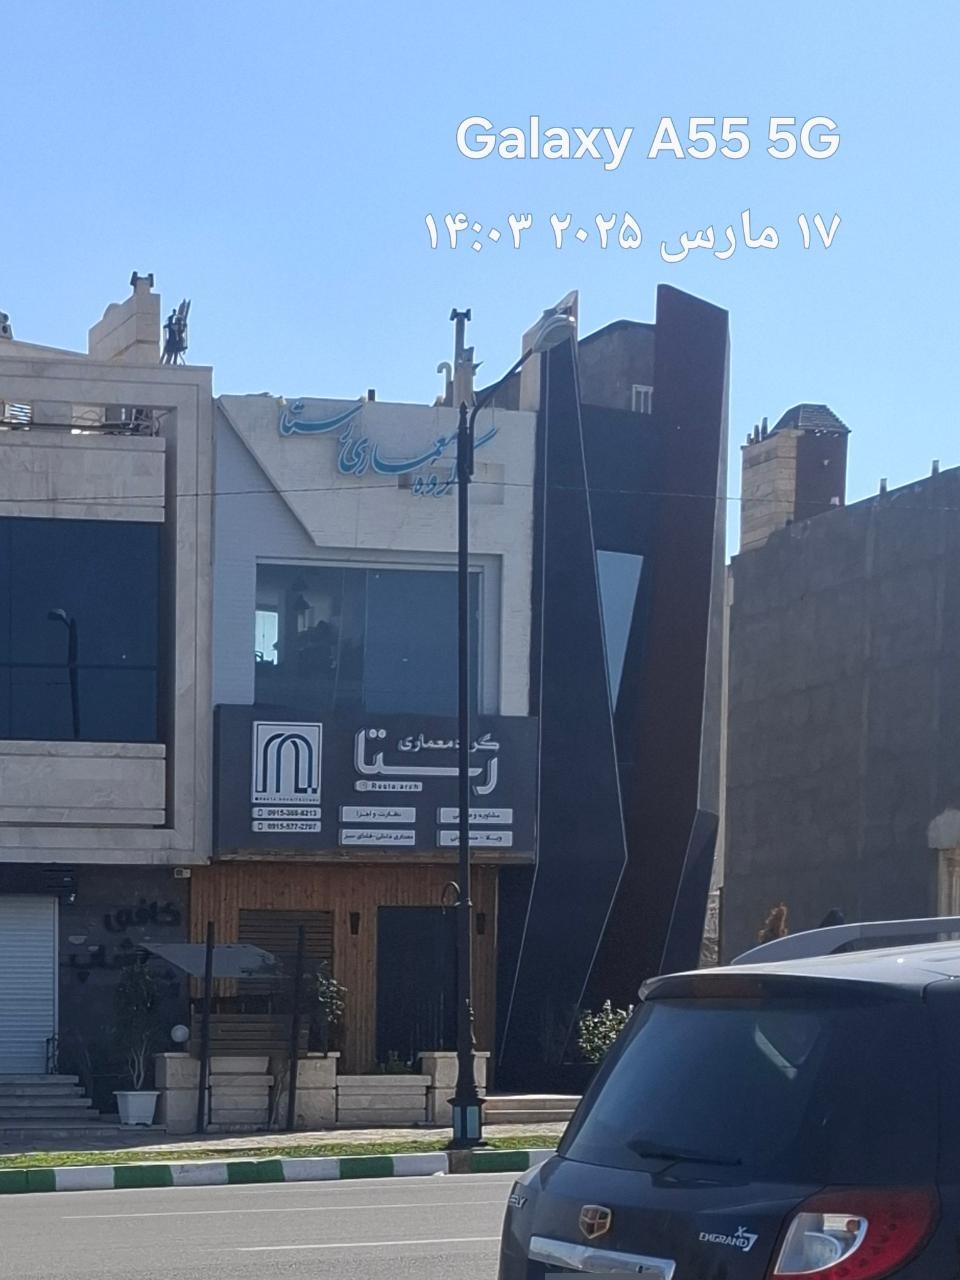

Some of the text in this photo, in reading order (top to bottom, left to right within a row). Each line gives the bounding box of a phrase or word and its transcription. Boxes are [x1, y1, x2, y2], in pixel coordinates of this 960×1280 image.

[354, 728, 498, 795] رستا
[398, 733, 500, 752] گر معماری
